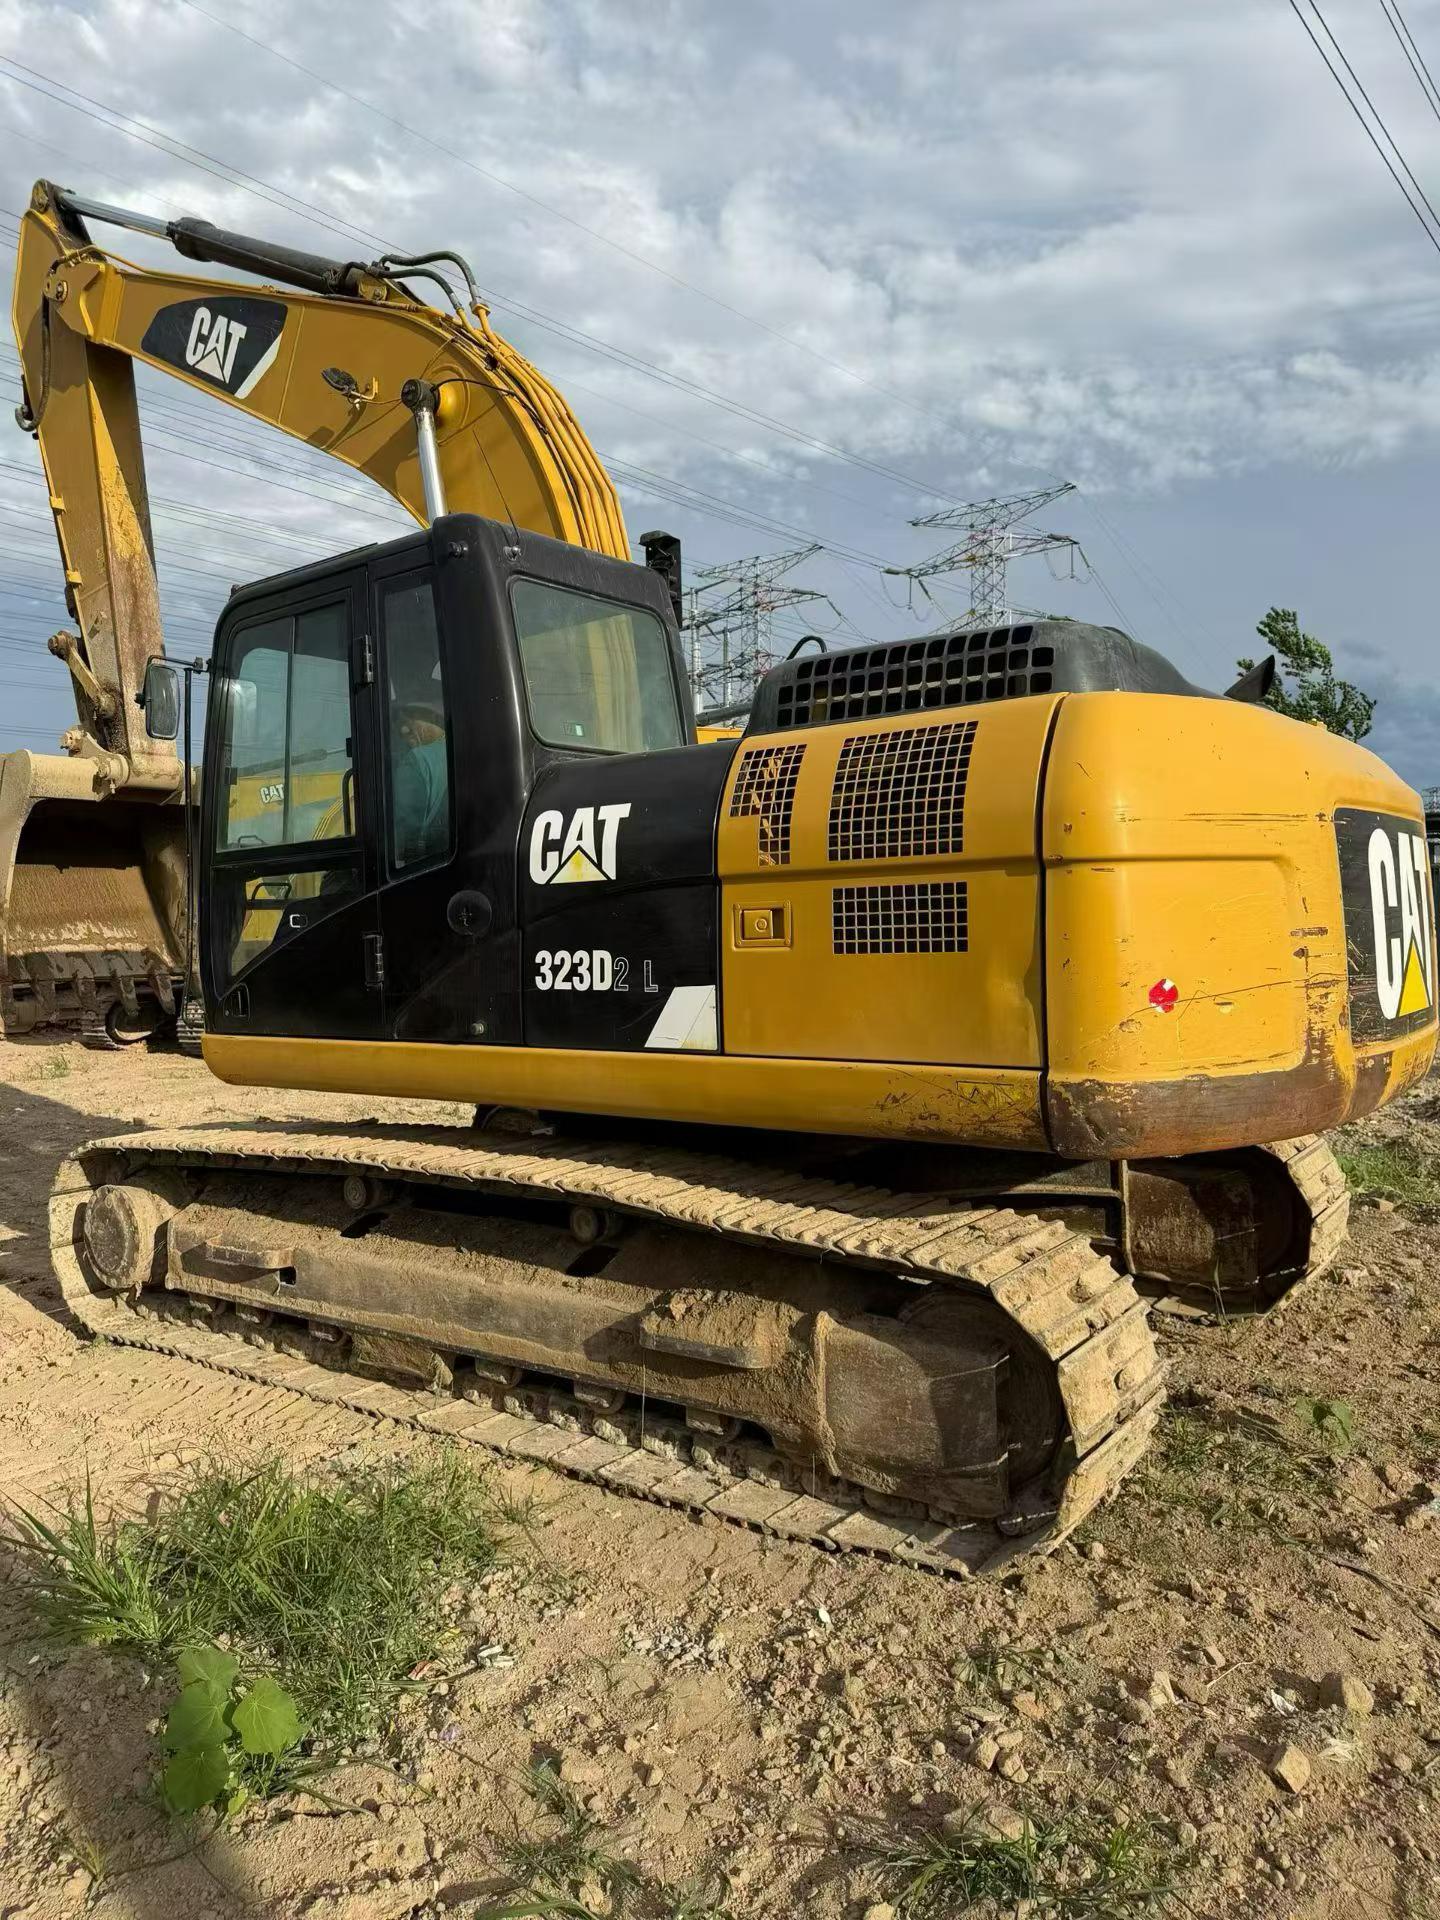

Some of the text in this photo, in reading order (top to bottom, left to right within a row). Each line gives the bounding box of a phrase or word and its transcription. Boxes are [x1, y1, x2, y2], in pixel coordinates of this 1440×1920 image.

[185, 306, 248, 384] CAT
[260, 783, 285, 803] CAT
[529, 802, 632, 885] CAT
[1367, 828, 1433, 1020] CAT
[643, 959, 659, 992] L
